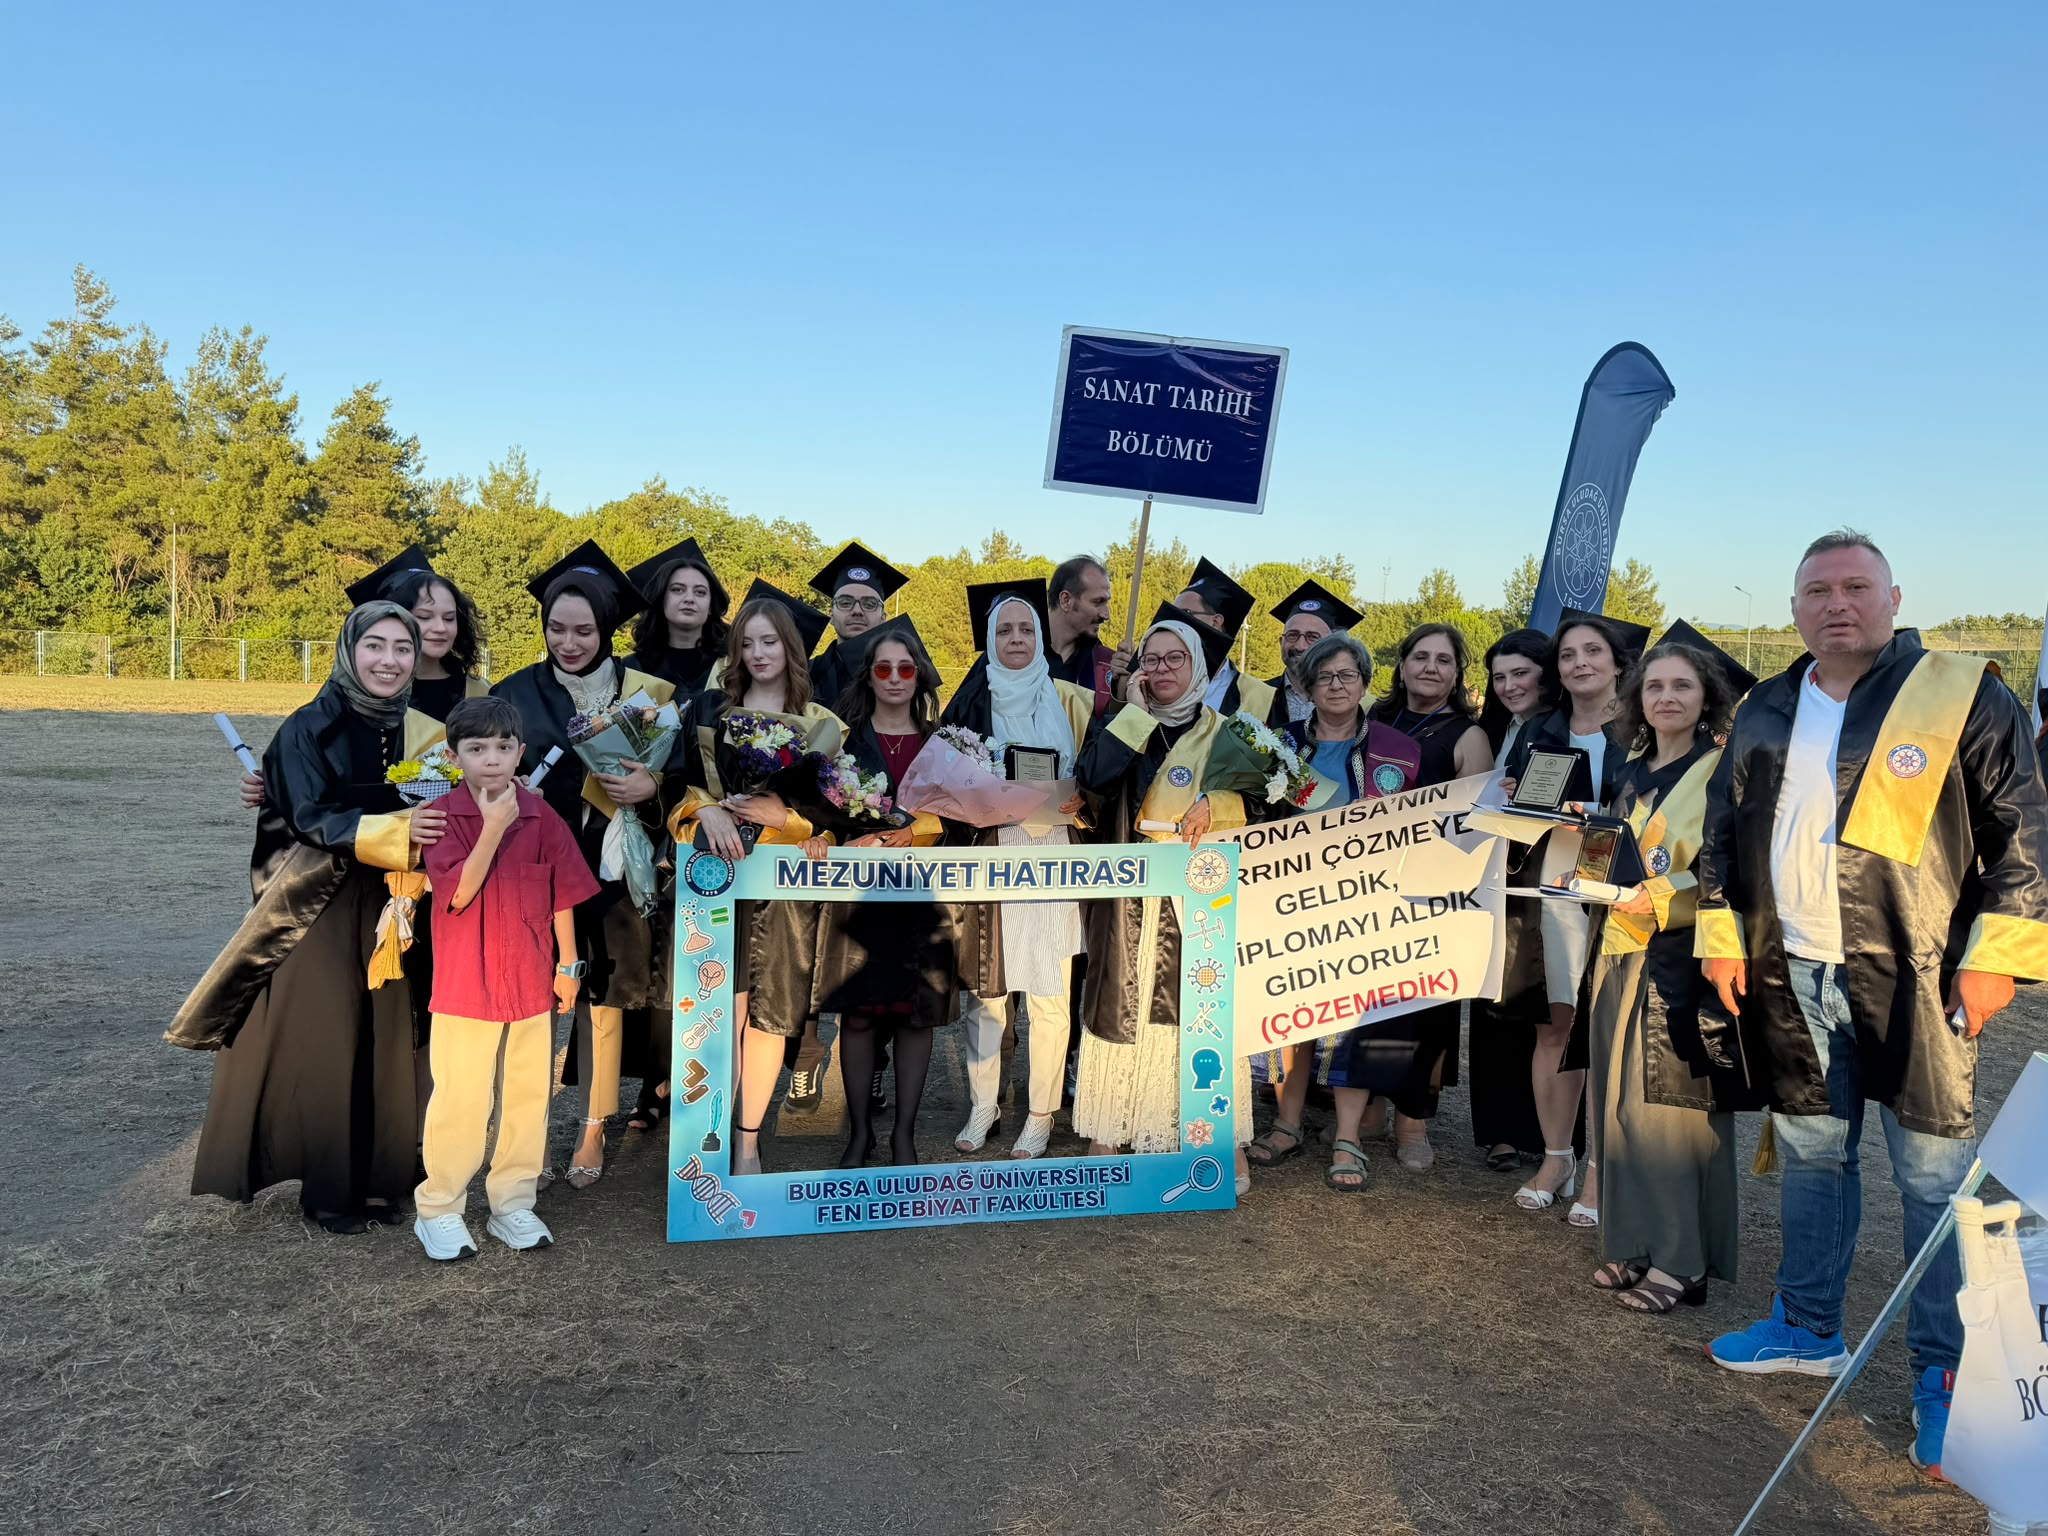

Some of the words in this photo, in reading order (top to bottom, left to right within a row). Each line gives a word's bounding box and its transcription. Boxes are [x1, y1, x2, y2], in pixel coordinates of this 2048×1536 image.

[1083, 376, 1161, 406] SANAT
[1167, 385, 1253, 417] TARİHİ
[1107, 429, 1214, 463] BÖLÜMÜ
[1556, 508, 1571, 556] BURSA
[1321, 811, 1474, 871] ÇÖZMEYE
[776, 854, 981, 890] MEZUNİYET
[986, 857, 1149, 890] HATIRASI
[1275, 869, 1399, 916] GELDİK,
[1234, 911, 1380, 967] İPLOMAYI
[1390, 887, 1482, 928] ALDIK
[1265, 935, 1441, 997] GİDİYORUZ!
[1261, 968, 1459, 1045] (ÇÖZEMEDİK)
[787, 1178, 870, 1203] BURSA
[876, 1169, 974, 1197] ULUDAĞ
[979, 1161, 1131, 1191] ÜNİVERSİTESİ
[816, 1202, 862, 1225] FEN
[867, 1194, 981, 1221] EDEBİYAT
[986, 1185, 1107, 1214] FAKÜLTESİ
